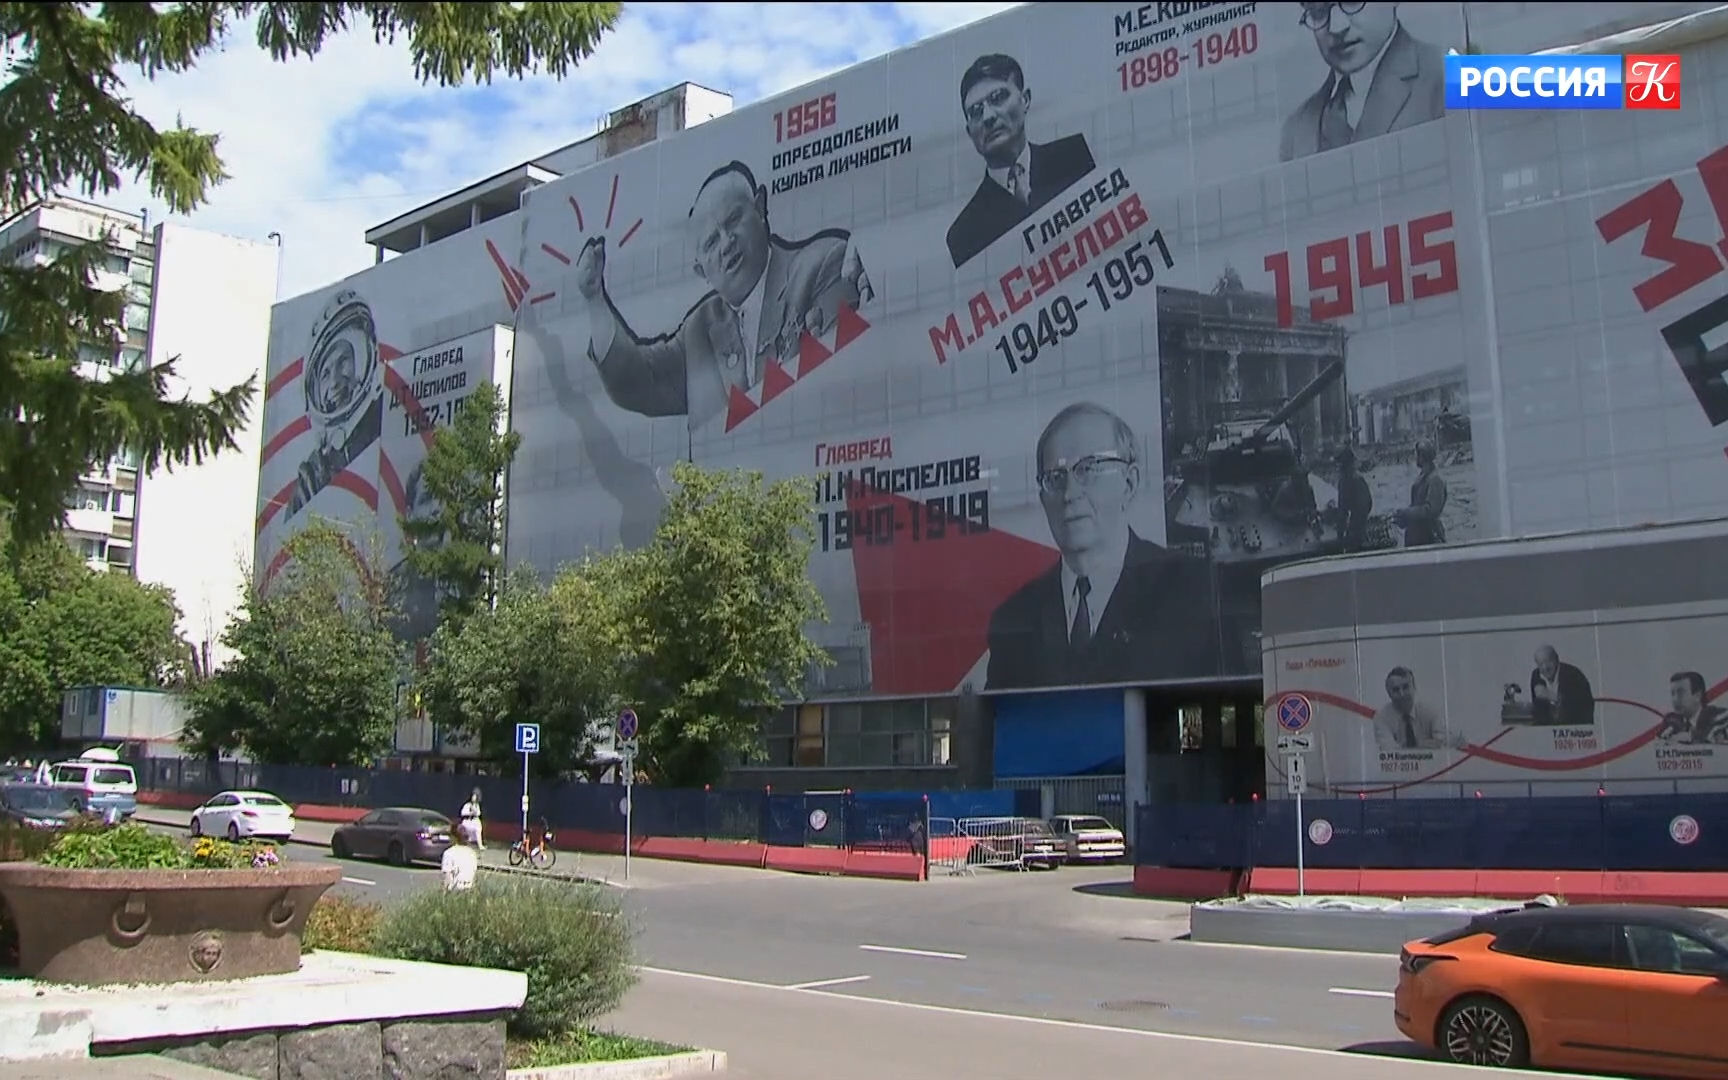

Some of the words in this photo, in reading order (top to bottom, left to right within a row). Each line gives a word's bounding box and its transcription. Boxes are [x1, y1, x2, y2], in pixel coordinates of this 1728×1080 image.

[1117, 22, 1258, 92] 1898-1940
[773, 92, 837, 144] 1956
[771, 163, 825, 195] КУЛЬТА
[828, 136, 912, 178] ЛИЧНОСТИ
[995, 229, 1175, 374] 1949-1951
[1263, 211, 1458, 329] 1945
[818, 489, 990, 553] 1940-1949
